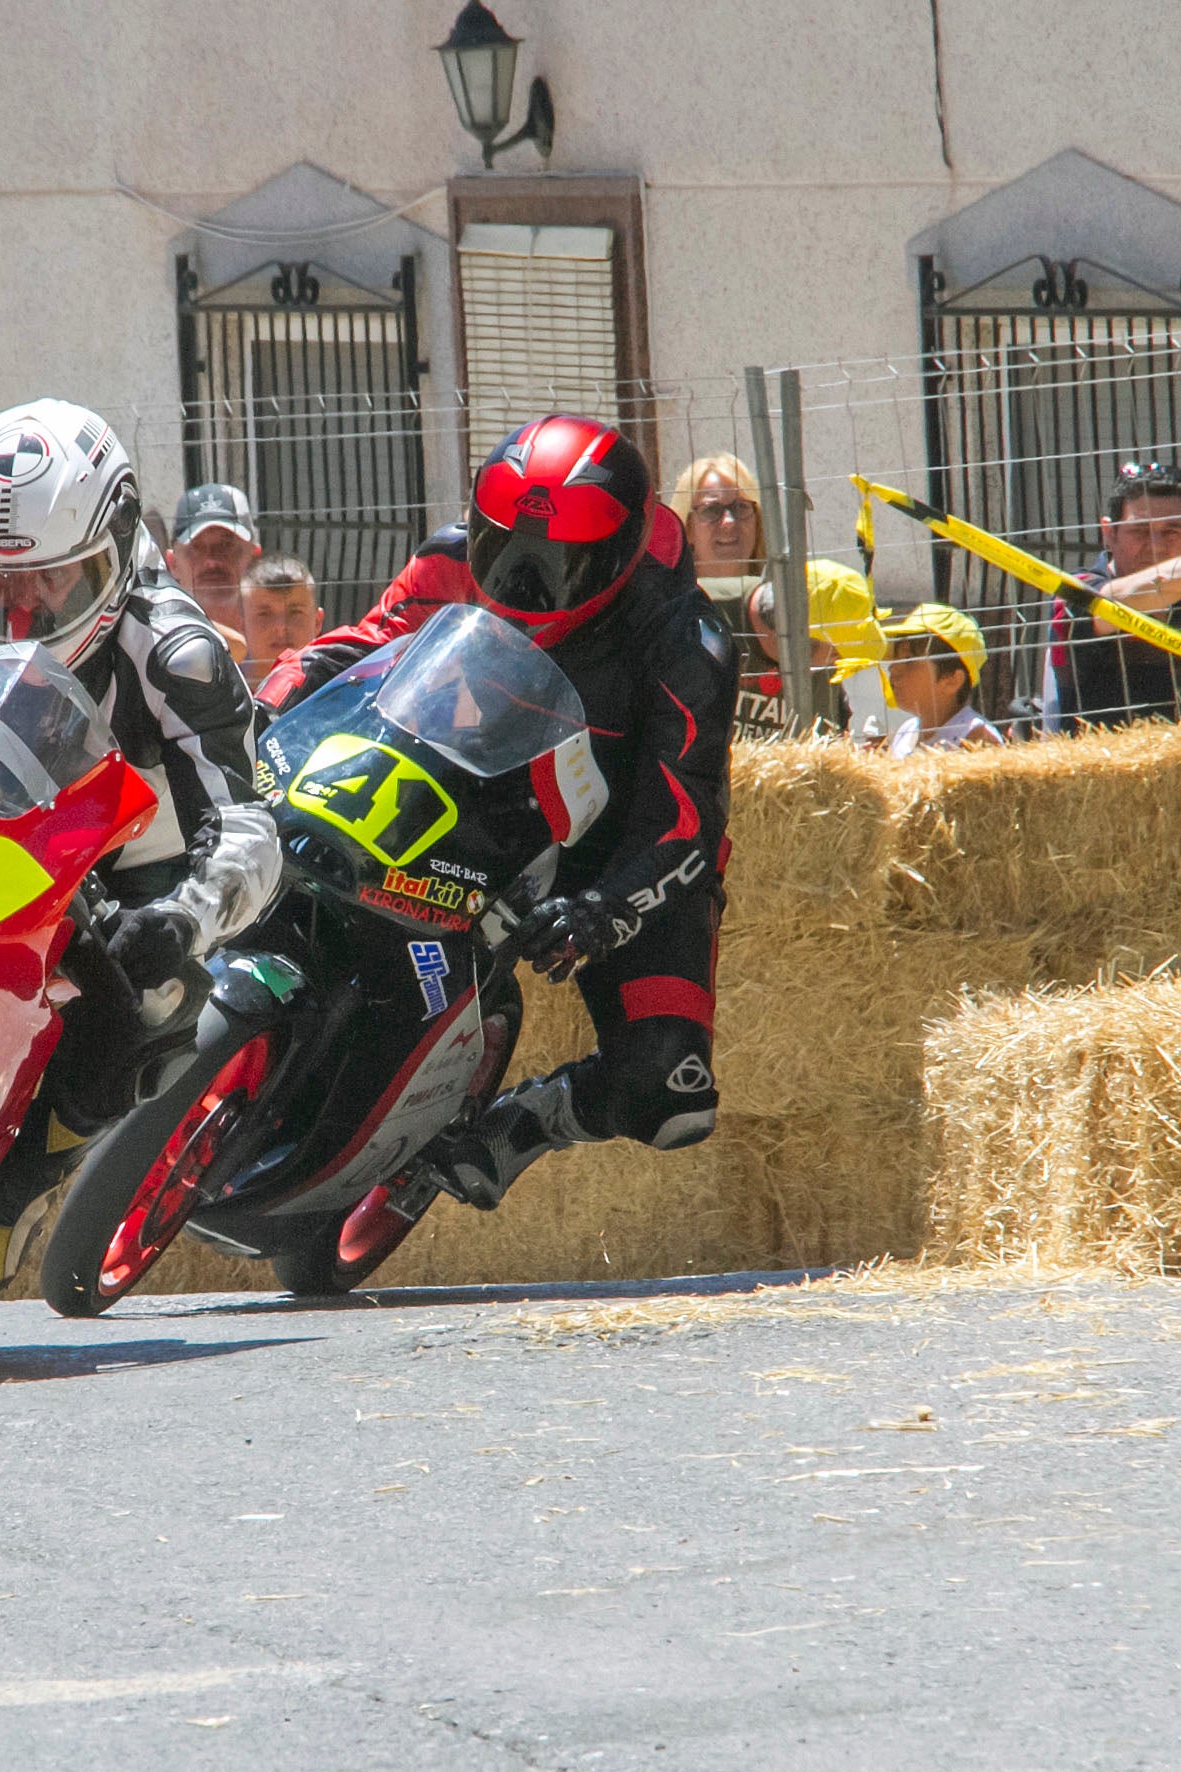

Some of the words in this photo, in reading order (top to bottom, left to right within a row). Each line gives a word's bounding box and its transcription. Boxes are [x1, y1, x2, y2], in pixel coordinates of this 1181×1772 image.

[294, 746, 448, 862] 41
[359, 885, 472, 932] KIRONATURA
[382, 866, 464, 909] italkit
